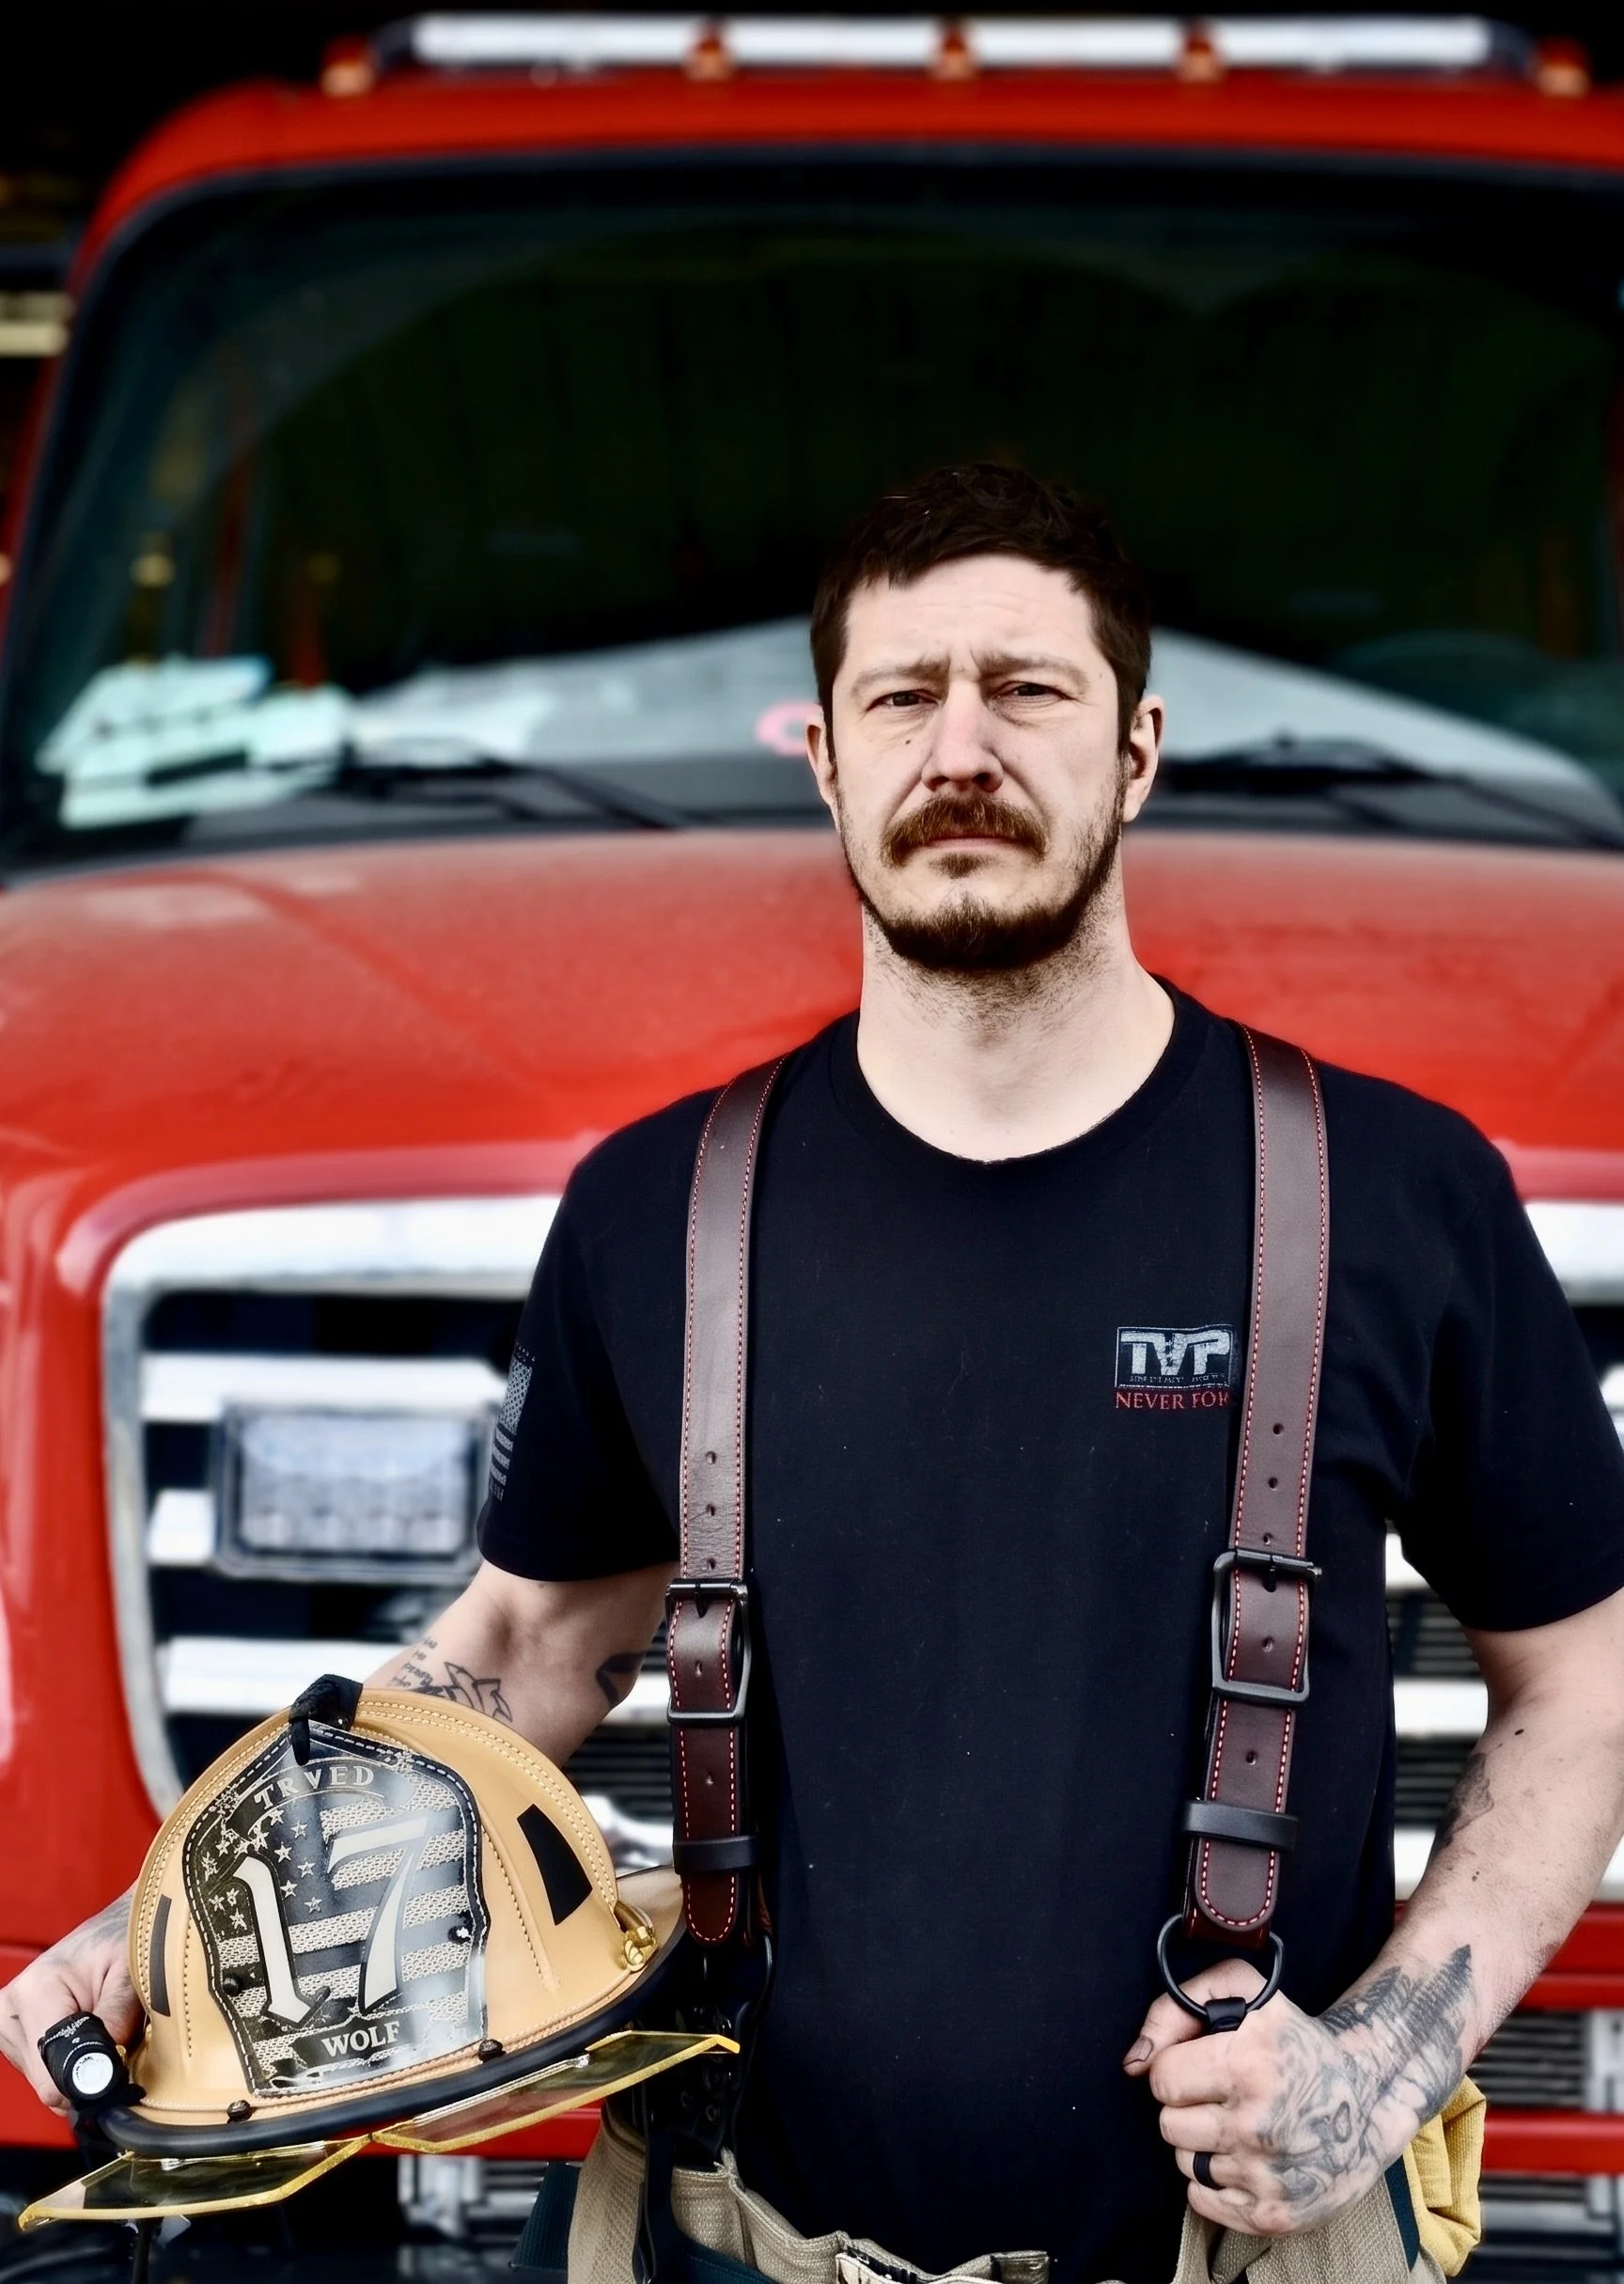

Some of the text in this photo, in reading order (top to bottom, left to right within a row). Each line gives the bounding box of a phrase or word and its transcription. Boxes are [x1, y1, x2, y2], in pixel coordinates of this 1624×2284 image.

[1116, 1392, 1185, 1410] NEVER
[232, 1817, 429, 2024] 17
[321, 2021, 400, 2057] WOLF
